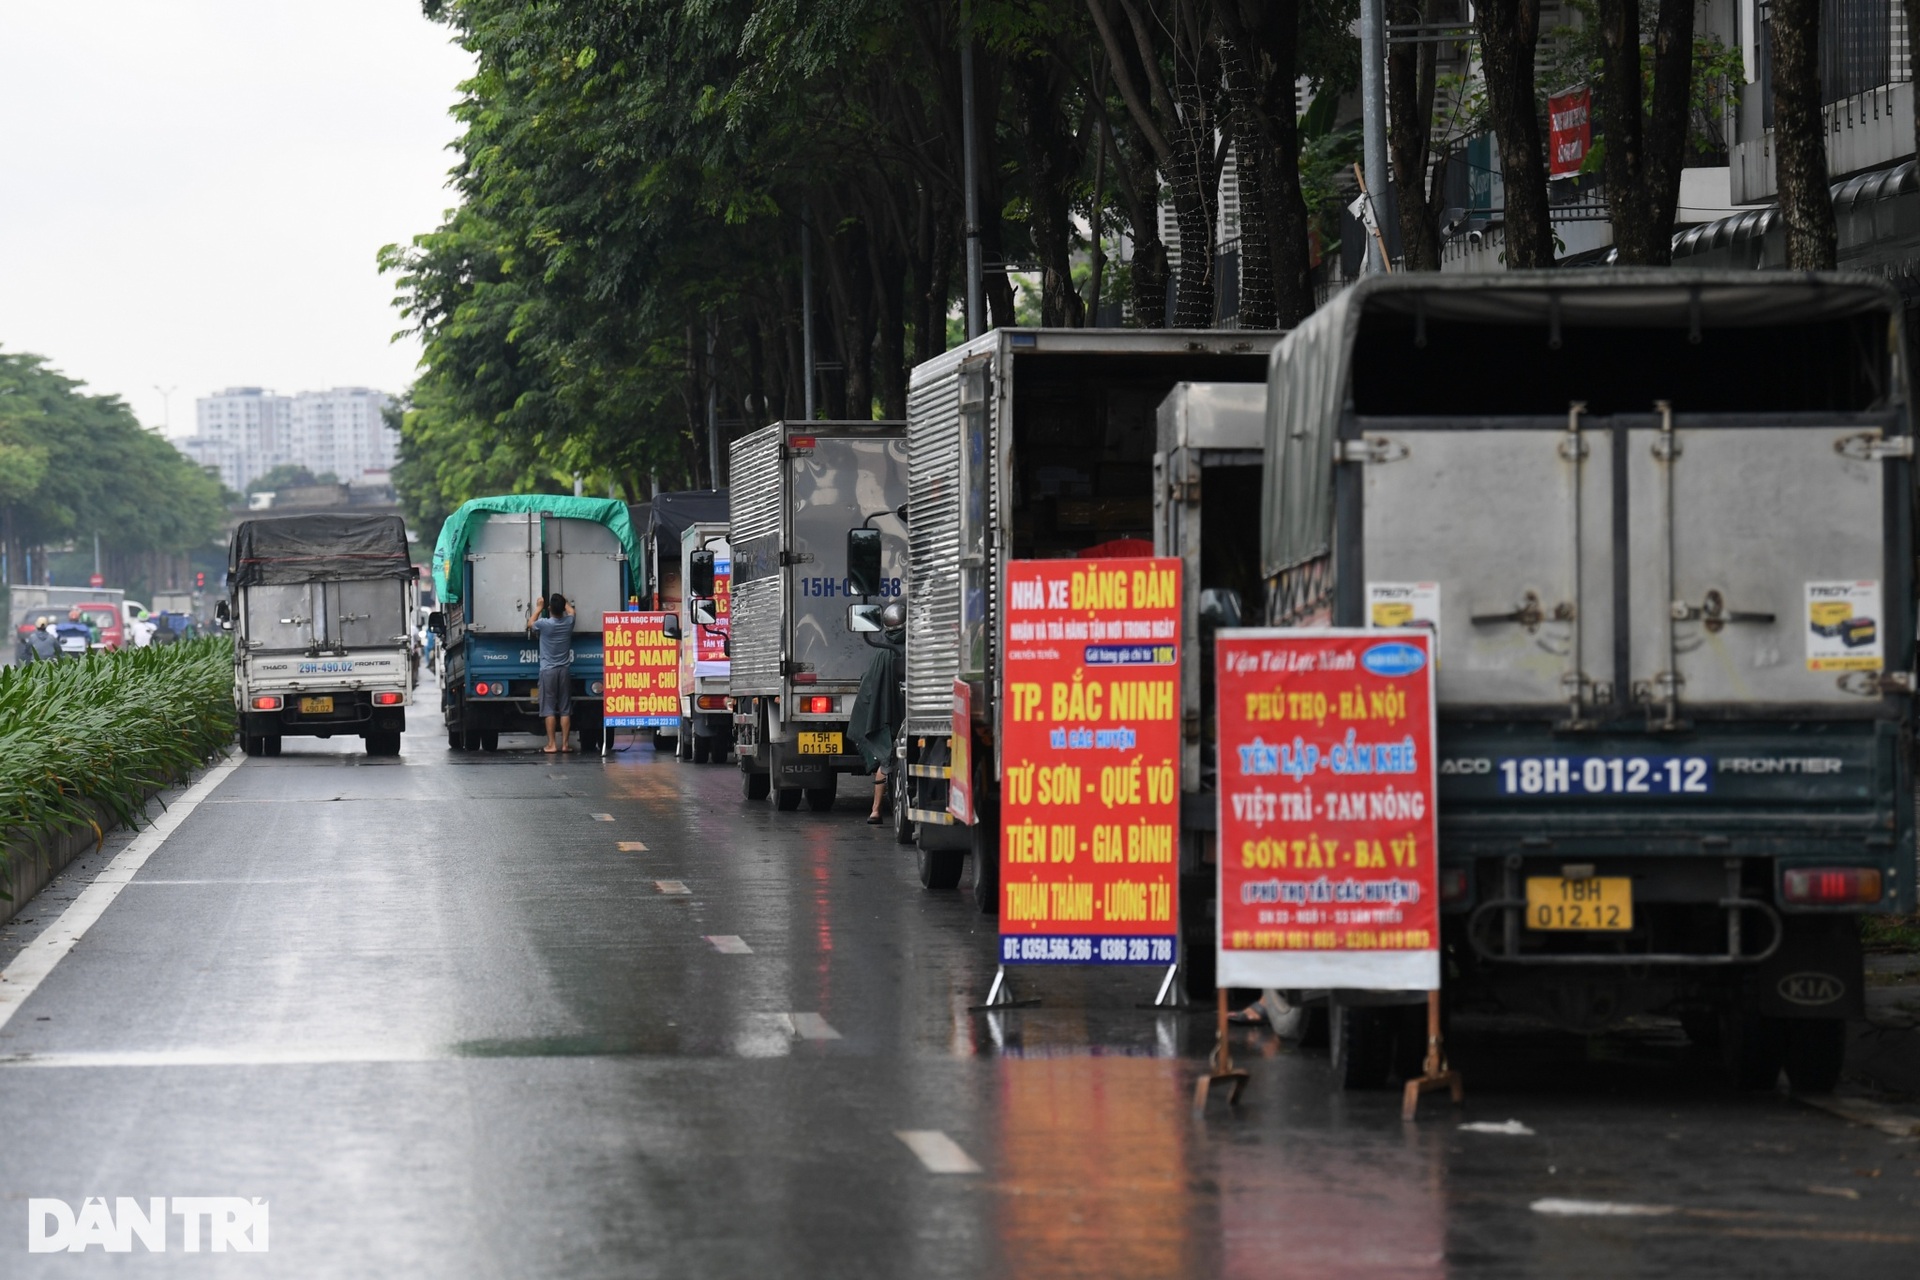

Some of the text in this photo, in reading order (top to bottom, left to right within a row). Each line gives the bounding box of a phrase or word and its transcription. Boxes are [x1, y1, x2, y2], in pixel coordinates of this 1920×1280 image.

[1011, 562, 1175, 618] NHÀ XE ĐẶNG ĐÀN
[605, 616, 619, 624] NHÀ
[621, 616, 629, 624] XE
[631, 616, 648, 625] NGỌC
[1152, 617, 1175, 638] NGÀY
[605, 625, 676, 647] BẮC GIANG
[605, 650, 677, 670] LỤC NAM
[1153, 647, 1173, 662] 10K
[299, 661, 352, 673] 29H-490.02
[606, 670, 677, 692] LỤC NGẠN CHŨ
[606, 693, 677, 715] SƠN ĐỘNG
[1011, 682, 1044, 721] TP.
[1052, 667, 1103, 721] BẮC
[1110, 681, 1173, 720] NINH
[1246, 683, 1406, 728] PHÚ THỌ HÀ NỘI
[811, 732, 831, 742] 15H
[1050, 726, 1136, 752] VÀ CÁC HUYỆN
[803, 744, 838, 754] 011.58
[1238, 736, 1278, 775] YÊN
[1280, 736, 1319, 782] LẬP
[1376, 735, 1417, 774] KHÊ
[781, 764, 822, 773] ISUZU
[1718, 759, 1843, 774] FRONTIER
[1007, 754, 1174, 809] TỪ SƠN QUẾ VÕ
[1231, 785, 1426, 829] VIỆT TRÌ TAM NÔNG
[1007, 816, 1172, 863] TIÊN DU GIA BÌNH
[1241, 832, 1417, 869] SƠN TÂY BA VÌ
[1560, 879, 1600, 901] 18H
[1006, 874, 1170, 929] THUẬN THÀNH LƯƠNG TÀI
[1538, 904, 1620, 927] 012.12
[1789, 978, 1834, 997] KIA
